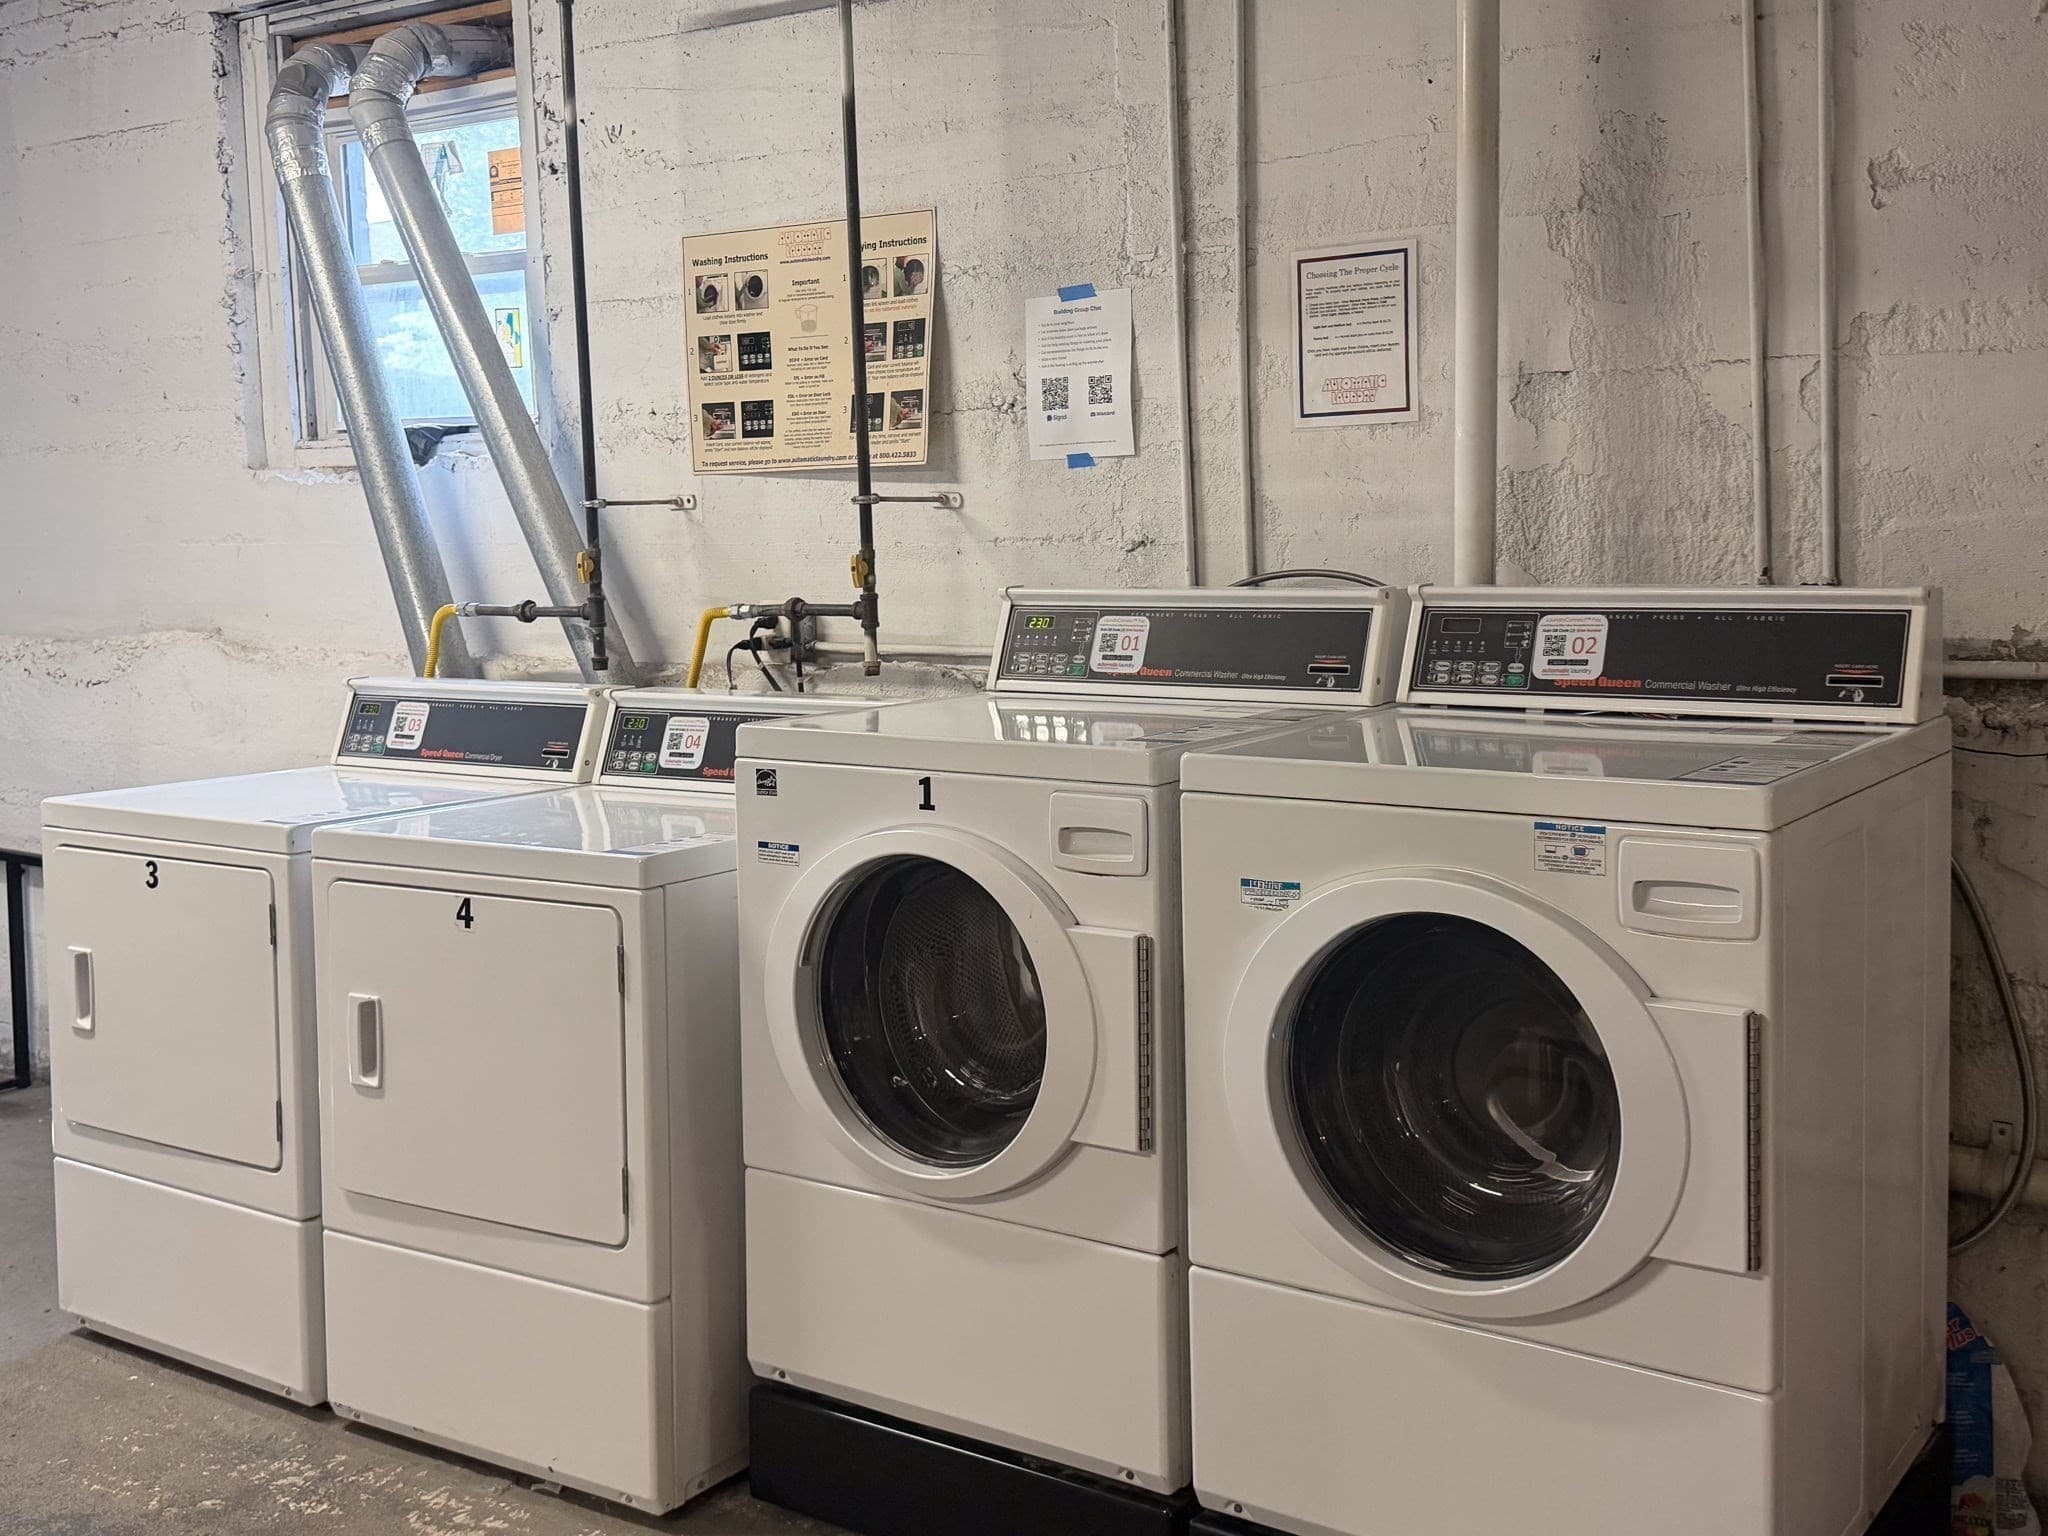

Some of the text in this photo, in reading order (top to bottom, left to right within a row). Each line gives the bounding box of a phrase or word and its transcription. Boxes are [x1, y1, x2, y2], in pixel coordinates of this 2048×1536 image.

[778, 227, 832, 245] AUTOMATIC
[861, 236, 927, 252] ying Instructions
[692, 253, 768, 266] Washing Instructions
[1306, 263, 1399, 279] Choosing The Proper Cycle
[792, 278, 820, 286] Important
[844, 336, 848, 344] 2
[1322, 374, 1386, 392] AUTOMATIC
[1331, 389, 1376, 405] LAUNDRY
[843, 406, 847, 414] 3
[693, 414, 698, 422] 3
[1029, 618, 1050, 628] 230
[1121, 636, 1140, 651] 01
[1572, 637, 1597, 654] 02
[1140, 666, 1173, 677] Queen
[1174, 668, 1212, 678] Commercial
[1214, 670, 1238, 679] Washer
[1600, 677, 1641, 688] Queen
[1645, 680, 1695, 690] Commercial
[1698, 681, 1731, 691] Washer
[1767, 685, 1798, 694] Efficiency
[409, 719, 422, 731] 03
[628, 718, 645, 728] 230
[685, 735, 701, 749] 04
[421, 748, 442, 757] Speed
[443, 749, 464, 759] Queen
[465, 752, 489, 760] Commercial
[703, 766, 729, 776] Speed
[919, 776, 936, 811] 1
[145, 861, 159, 889] 3
[456, 898, 474, 928] 4
